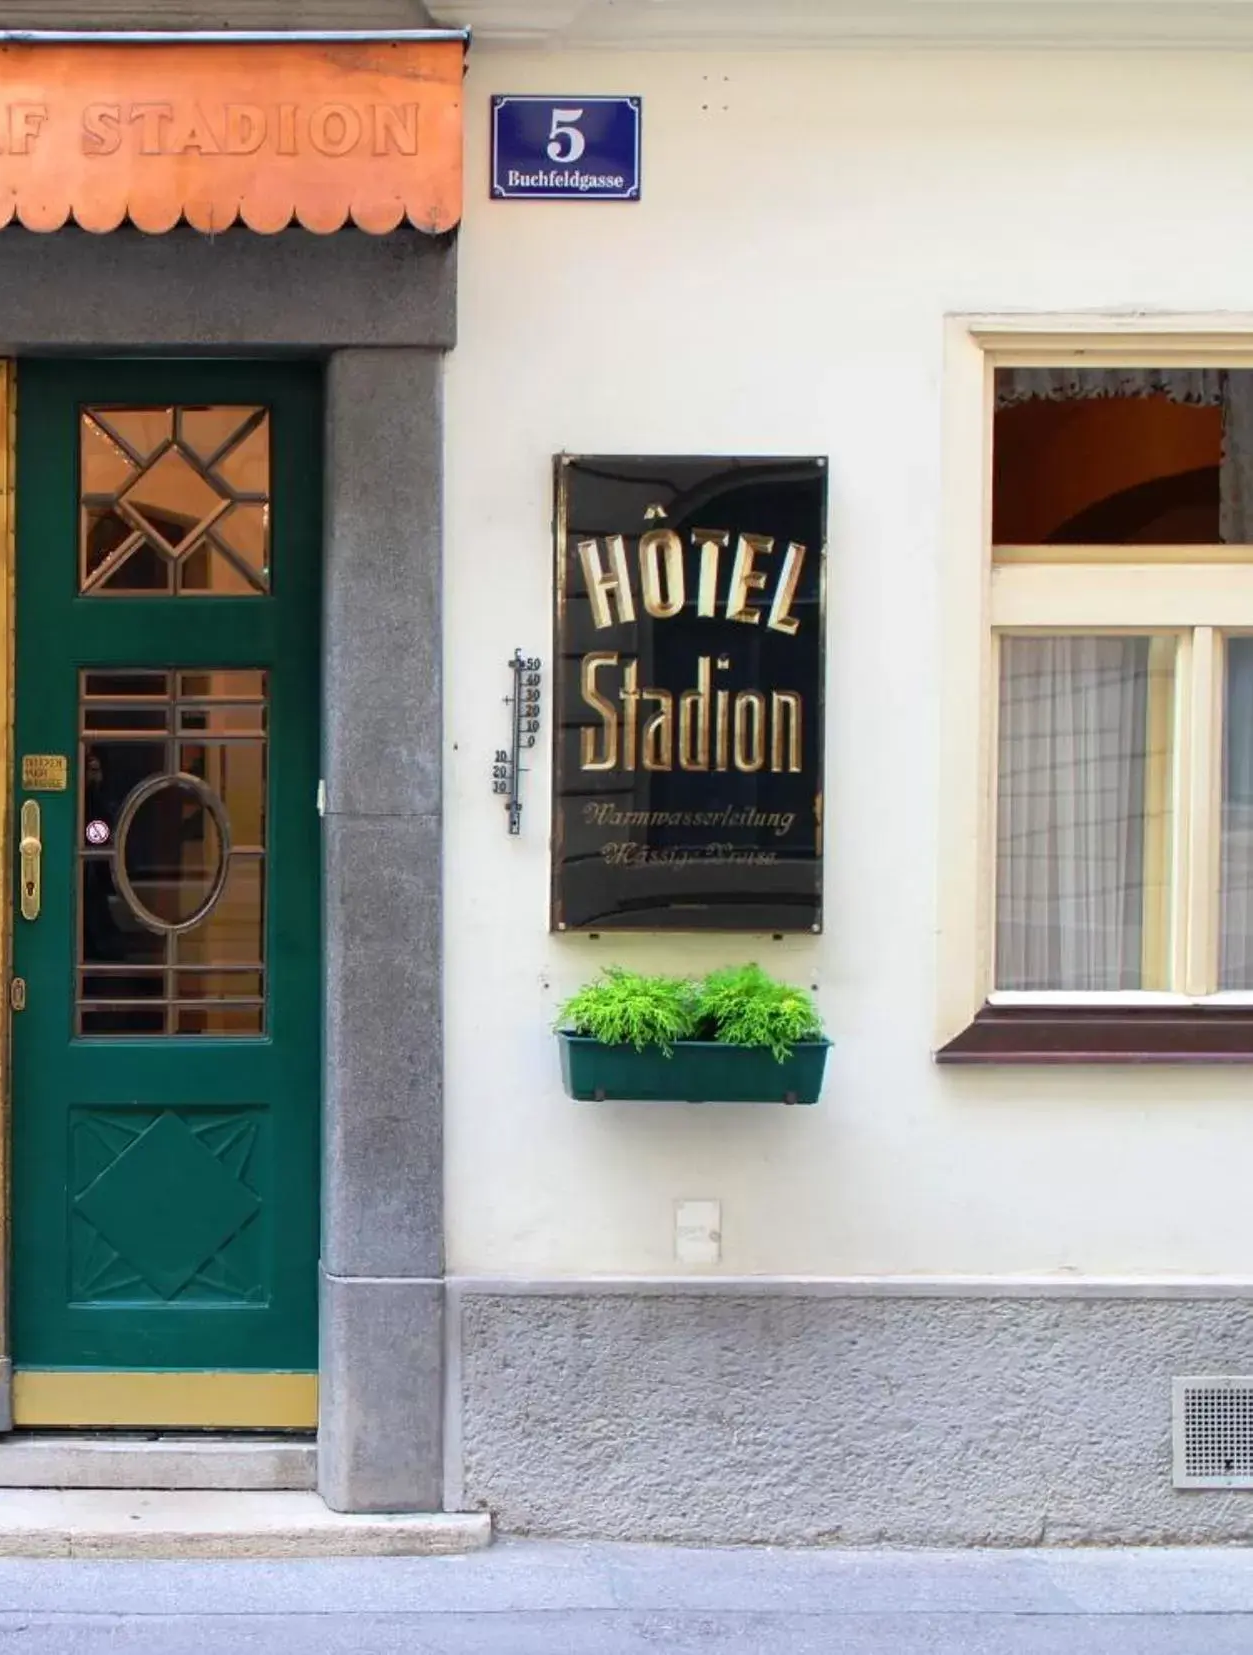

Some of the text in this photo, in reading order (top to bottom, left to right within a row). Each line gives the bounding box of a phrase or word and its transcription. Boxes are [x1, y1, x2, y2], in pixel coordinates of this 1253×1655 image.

[81, 102, 421, 157] STADION
[546, 108, 586, 163] 5
[508, 170, 624, 192] Buchfeldgasse
[577, 503, 807, 635] HÔTEL
[527, 658, 541, 671] 50
[526, 689, 540, 701] 30
[526, 705, 540, 717] 20
[579, 650, 803, 773] Stadion
[526, 720, 539, 732] 10
[528, 736, 536, 748] 0
[493, 765, 507, 778] 20
[583, 803, 795, 837] Warmwasserleitung
